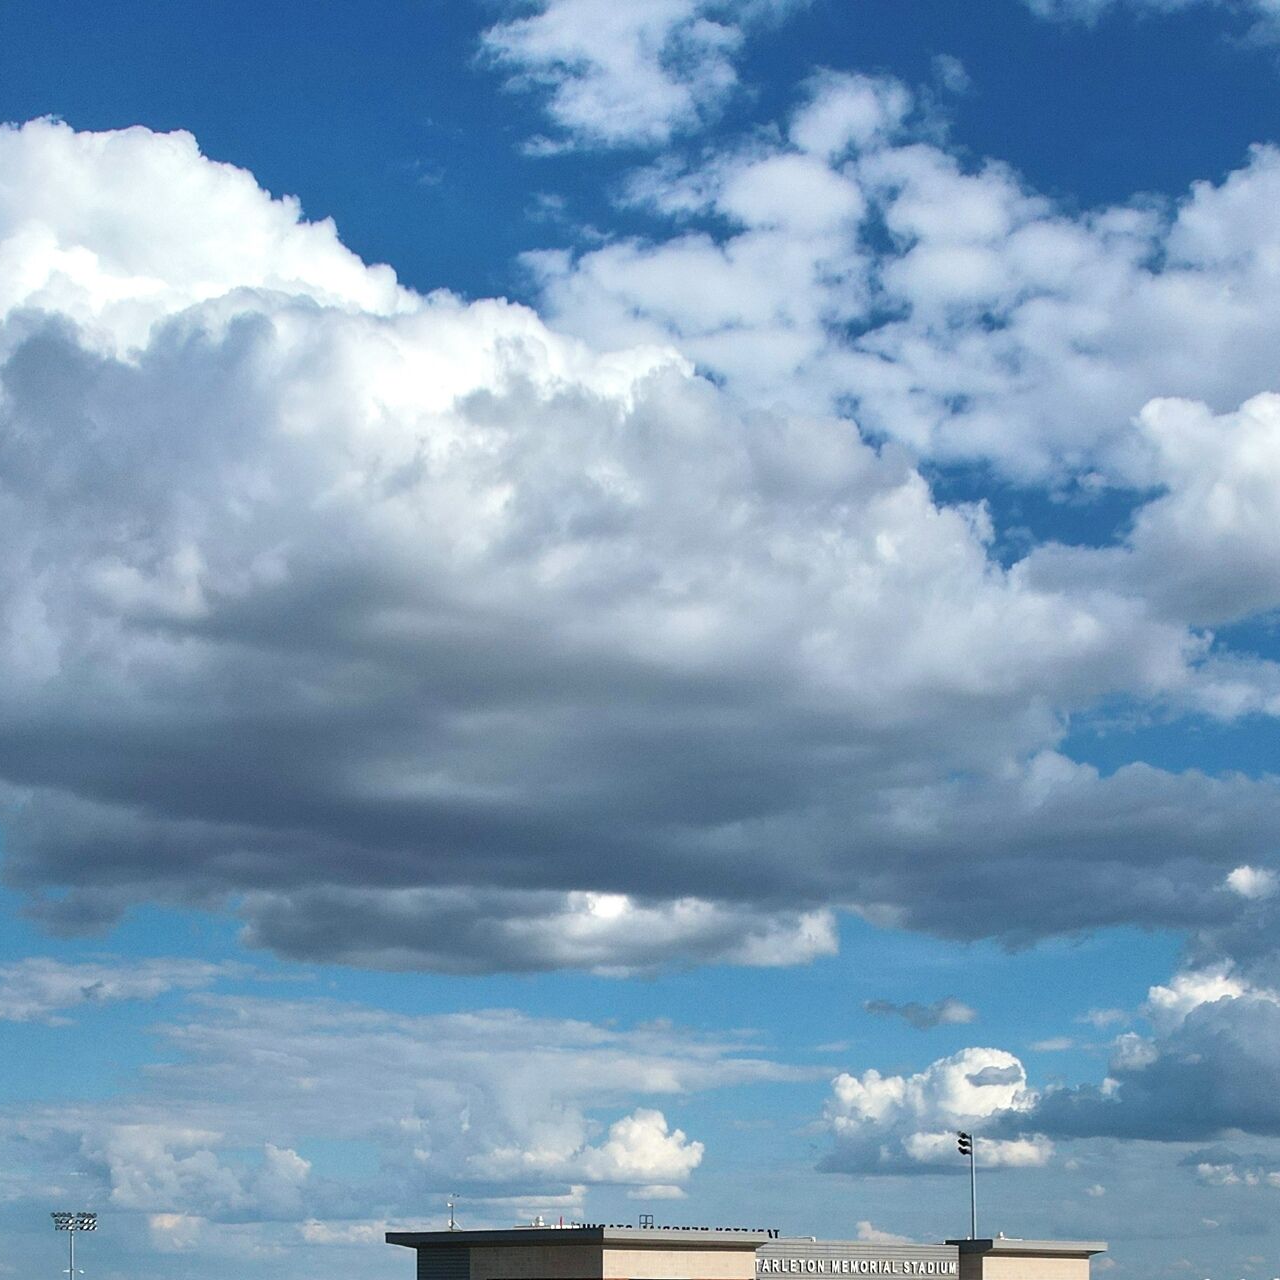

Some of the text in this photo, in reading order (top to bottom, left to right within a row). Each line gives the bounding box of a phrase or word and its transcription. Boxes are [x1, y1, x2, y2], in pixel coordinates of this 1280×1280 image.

[755, 1258, 957, 1274] TARLETON MEMORIAL STADIUM
